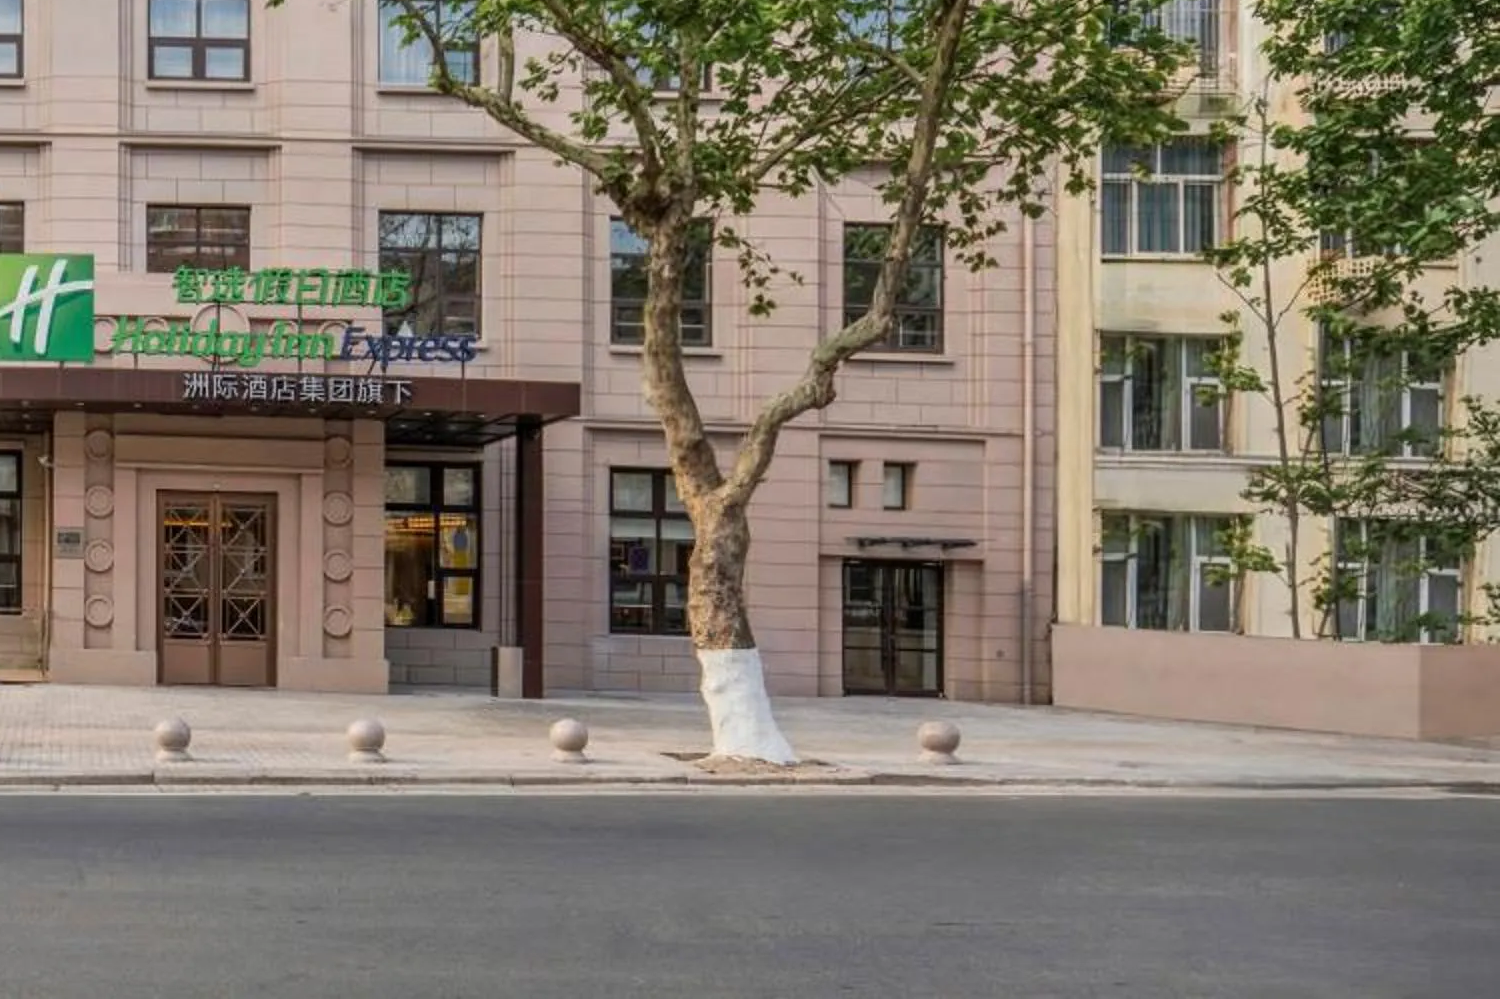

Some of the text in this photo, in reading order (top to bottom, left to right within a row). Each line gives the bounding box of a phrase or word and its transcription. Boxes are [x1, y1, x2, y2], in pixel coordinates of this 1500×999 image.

[173, 265, 411, 308] 智选假日酒店
[110, 315, 478, 369] Holiday Inn Express
[182, 372, 413, 403] 洲际酒店集团旗下
